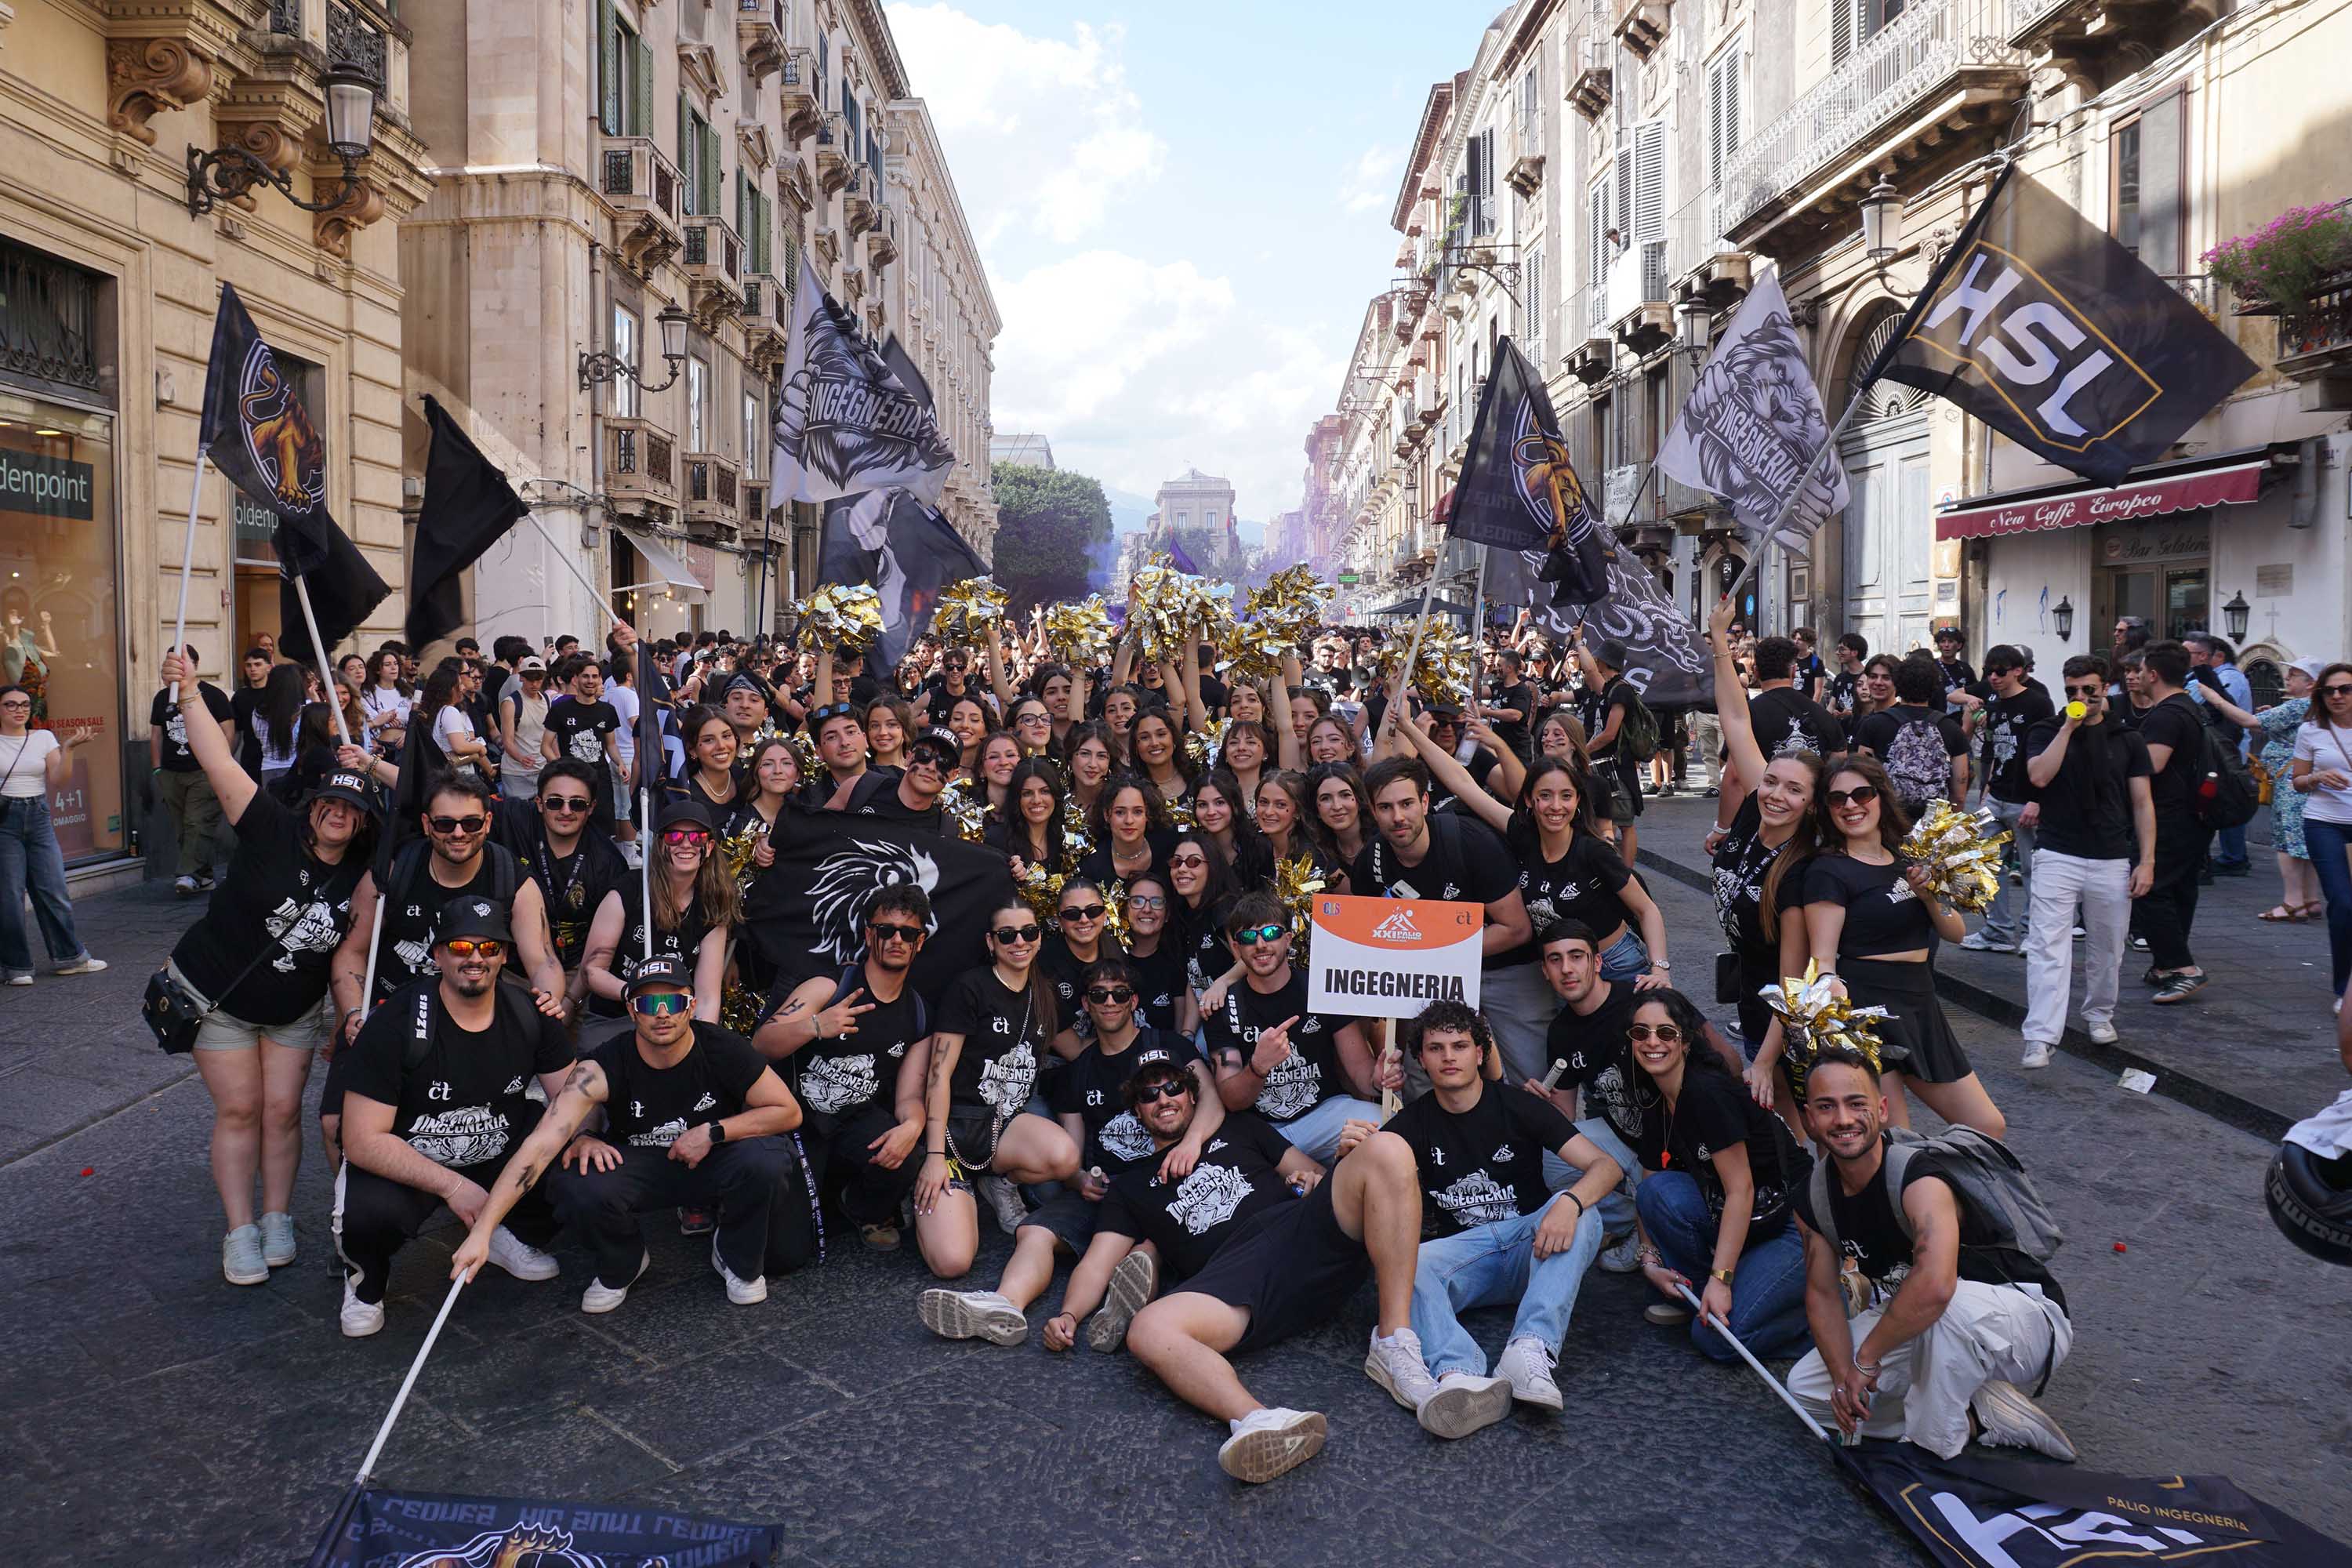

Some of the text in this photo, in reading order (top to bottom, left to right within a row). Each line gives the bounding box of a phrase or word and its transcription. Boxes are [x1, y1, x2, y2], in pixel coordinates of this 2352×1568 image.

[1923, 252, 2114, 437] HSL
[809, 381, 923, 440] INGEGNERIA
[1714, 401, 1801, 492] INGEGNERIA
[1990, 494, 2162, 528] New Caffè Europeo
[56, 717, 86, 730] SEASON
[87, 716, 105, 727] SALE
[332, 775, 361, 790] HSL
[639, 963, 671, 978] HSL
[1324, 967, 1465, 1001] INGEGNERIA
[1138, 1050, 1168, 1065] HSL
[1264, 1062, 1323, 1085] GEGNERIA
[427, 1081, 452, 1101] ct
[1087, 1089, 1105, 1106] ct
[2107, 1495, 2250, 1533] PALIO INGEGNERIA
